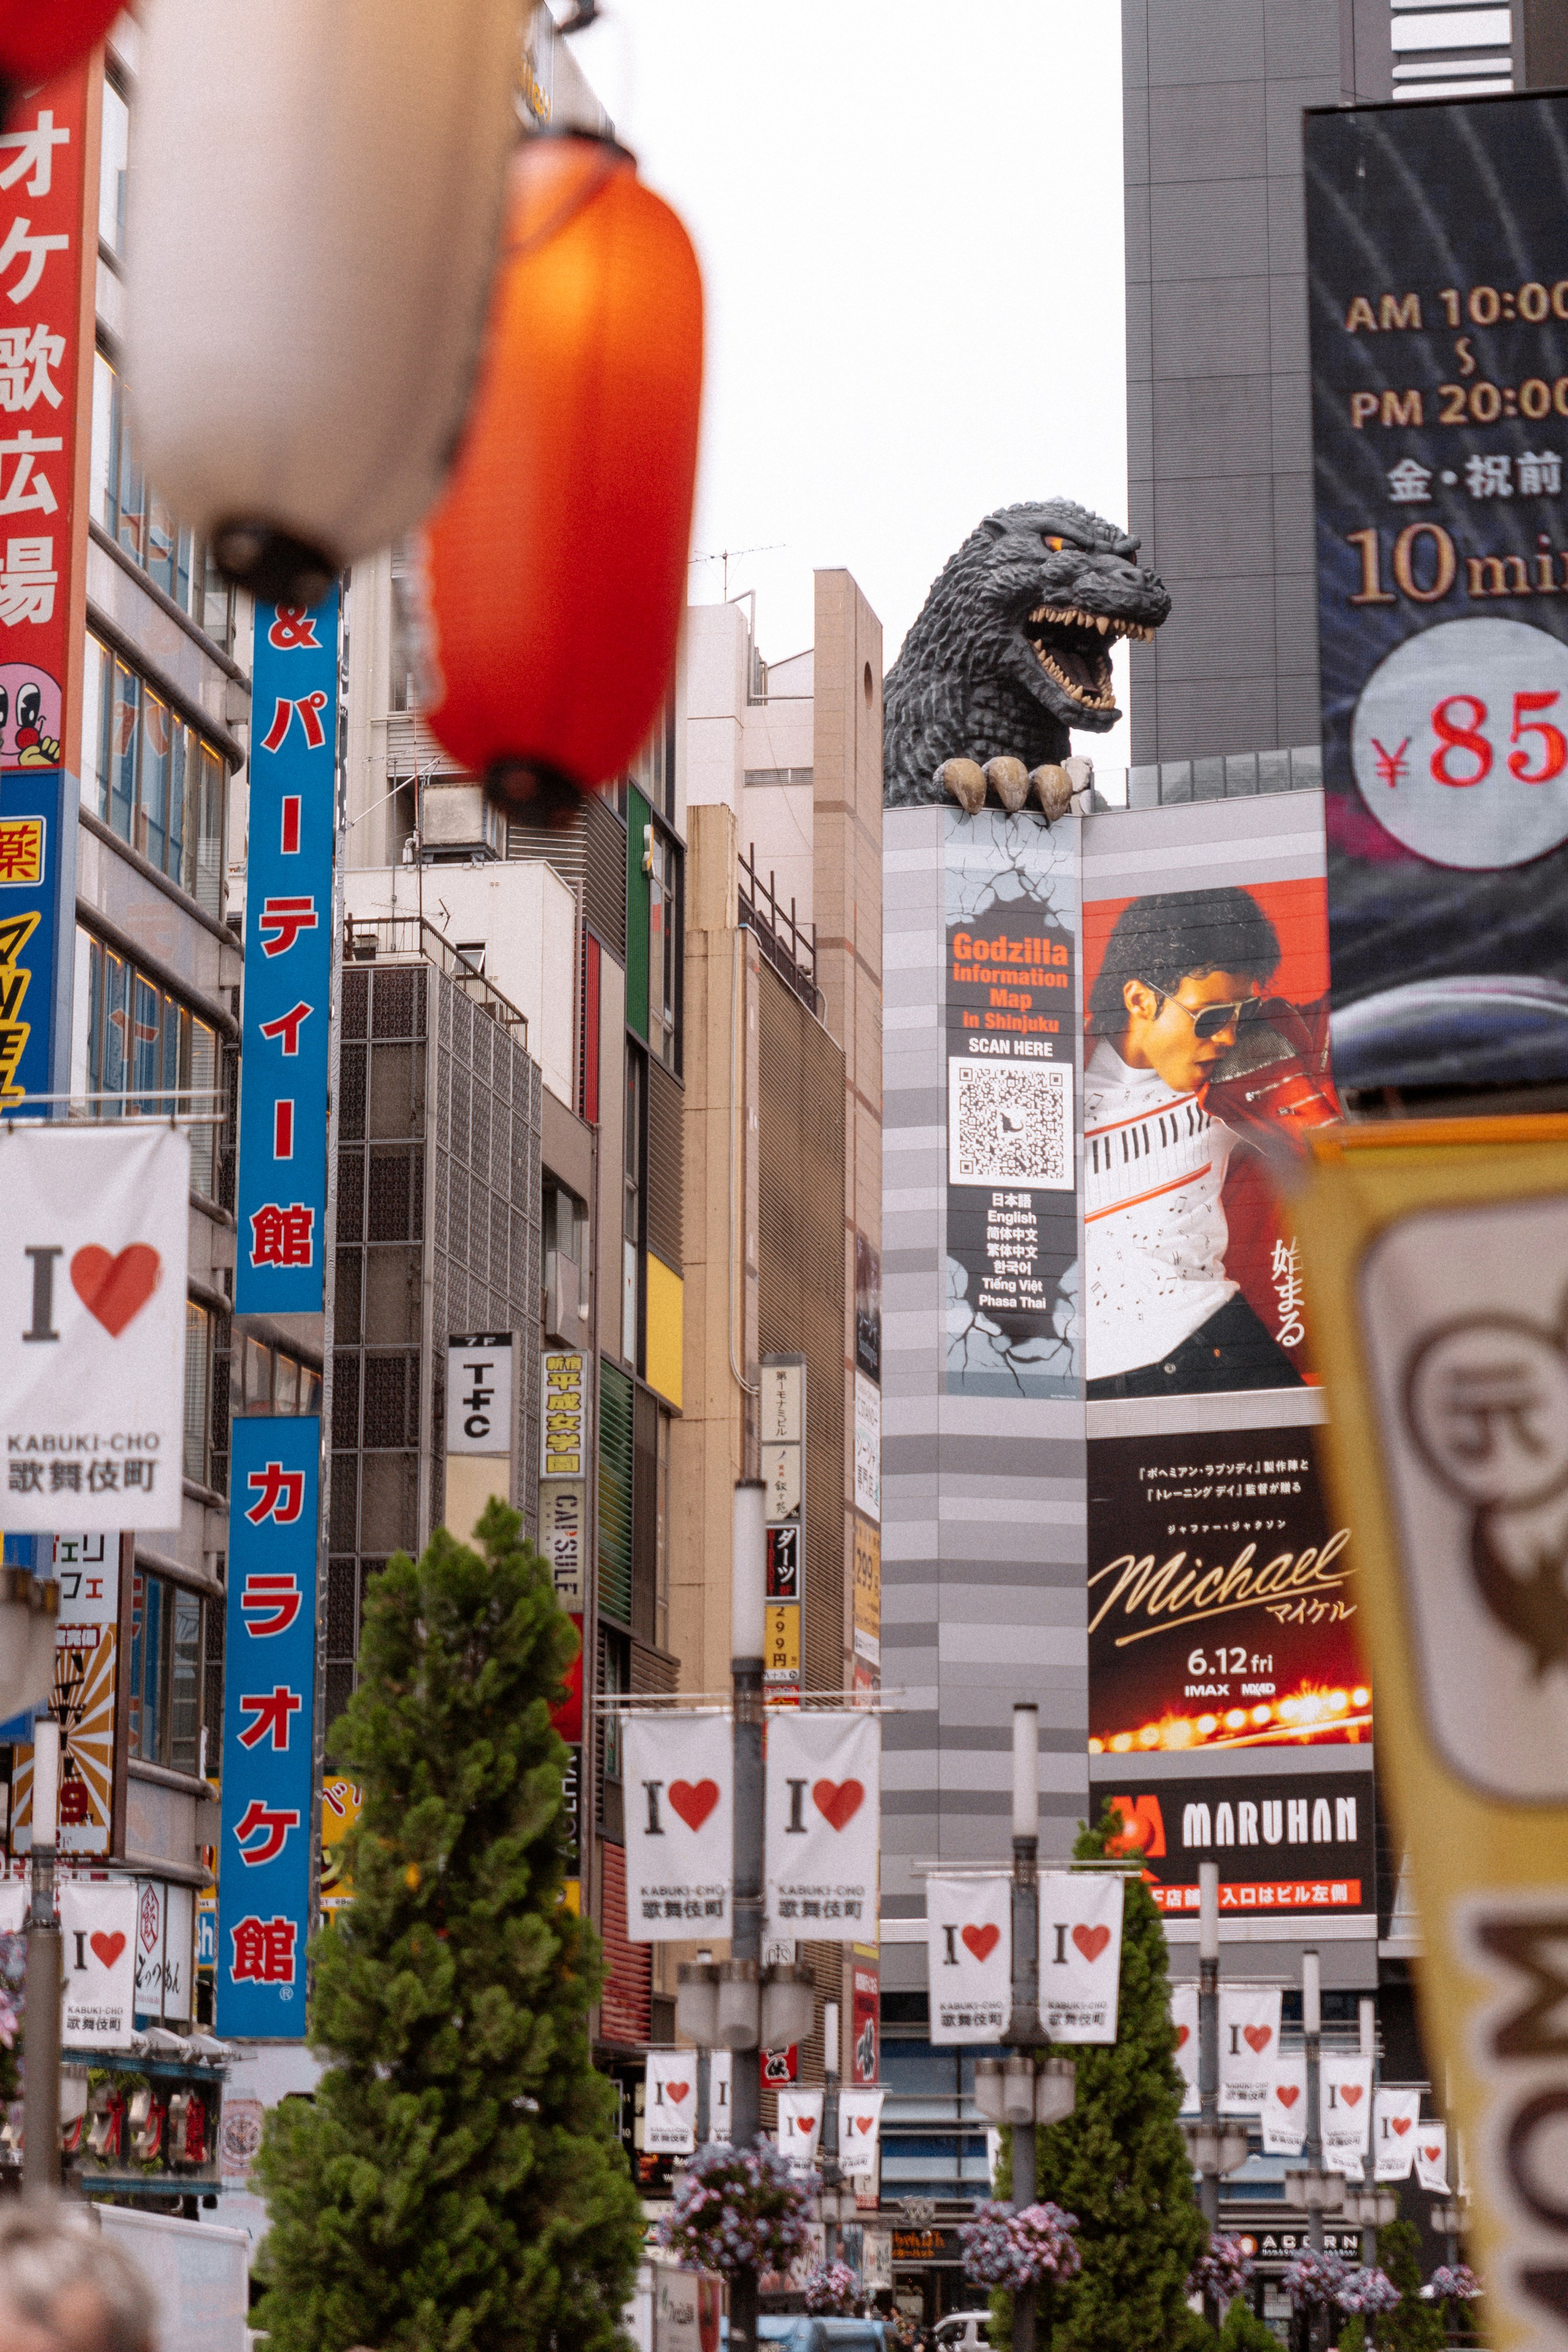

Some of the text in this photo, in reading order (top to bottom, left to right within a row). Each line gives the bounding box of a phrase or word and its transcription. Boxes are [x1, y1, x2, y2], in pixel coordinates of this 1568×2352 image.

[1345, 292, 1423, 332] AM
[1350, 389, 1424, 429] PM
[1387, 450, 1563, 503] 金・祝前
[953, 932, 1068, 966] Godzilla
[953, 962, 1068, 988] Information
[989, 988, 1032, 1012] Map
[963, 1011, 1060, 1035] in Shinjuku
[969, 1038, 1054, 1057] SCAN HERE
[992, 1193, 1031, 1208] 日本語
[987, 1210, 1037, 1226] English
[987, 1226, 1038, 1242] 简体中文
[987, 1243, 1038, 1259] 繁体中文
[993, 1260, 1031, 1276] 한국어
[982, 1276, 1043, 1294] Tiếng Việt
[979, 1294, 1046, 1309] Phasa Thai
[464, 1336, 496, 1346] 7F
[546, 1356, 582, 1371] 新宿
[7, 1432, 160, 1452] KABUKI-CHO
[8, 1458, 158, 1493] 歌舞伎町
[555, 1494, 578, 1594] CAPSULE
[777, 1529, 795, 1583] ダーツ
[1087, 1528, 1358, 1634] Michael
[1265, 1597, 1358, 1624] マイケル
[1187, 1646, 1273, 1676] 6.12 fri
[1184, 1684, 1230, 1697] IMAX
[229, 1461, 305, 1986] カラオケ館
[641, 1779, 665, 1834] I
[785, 1777, 808, 1833] I
[1182, 1796, 1357, 1848] MARUHAN
[641, 1884, 725, 1896] KABUKI-CHO
[778, 1883, 864, 1896] KABUKI-CHO
[1222, 1884, 1348, 1905] 入口はビル左側
[641, 1901, 724, 1919] 歌舞伎町
[778, 1900, 862, 1919] 歌舞伎町
[73, 1931, 87, 1970] I
[941, 1924, 959, 1965] I
[1053, 1923, 1068, 1964] I
[67, 2005, 123, 2015] KABUKI-CHO
[940, 2001, 1003, 2010] KABUKI-CHO
[66, 2015, 121, 2031] 歌舞伎町
[941, 2011, 1002, 2027] 歌舞伎町
